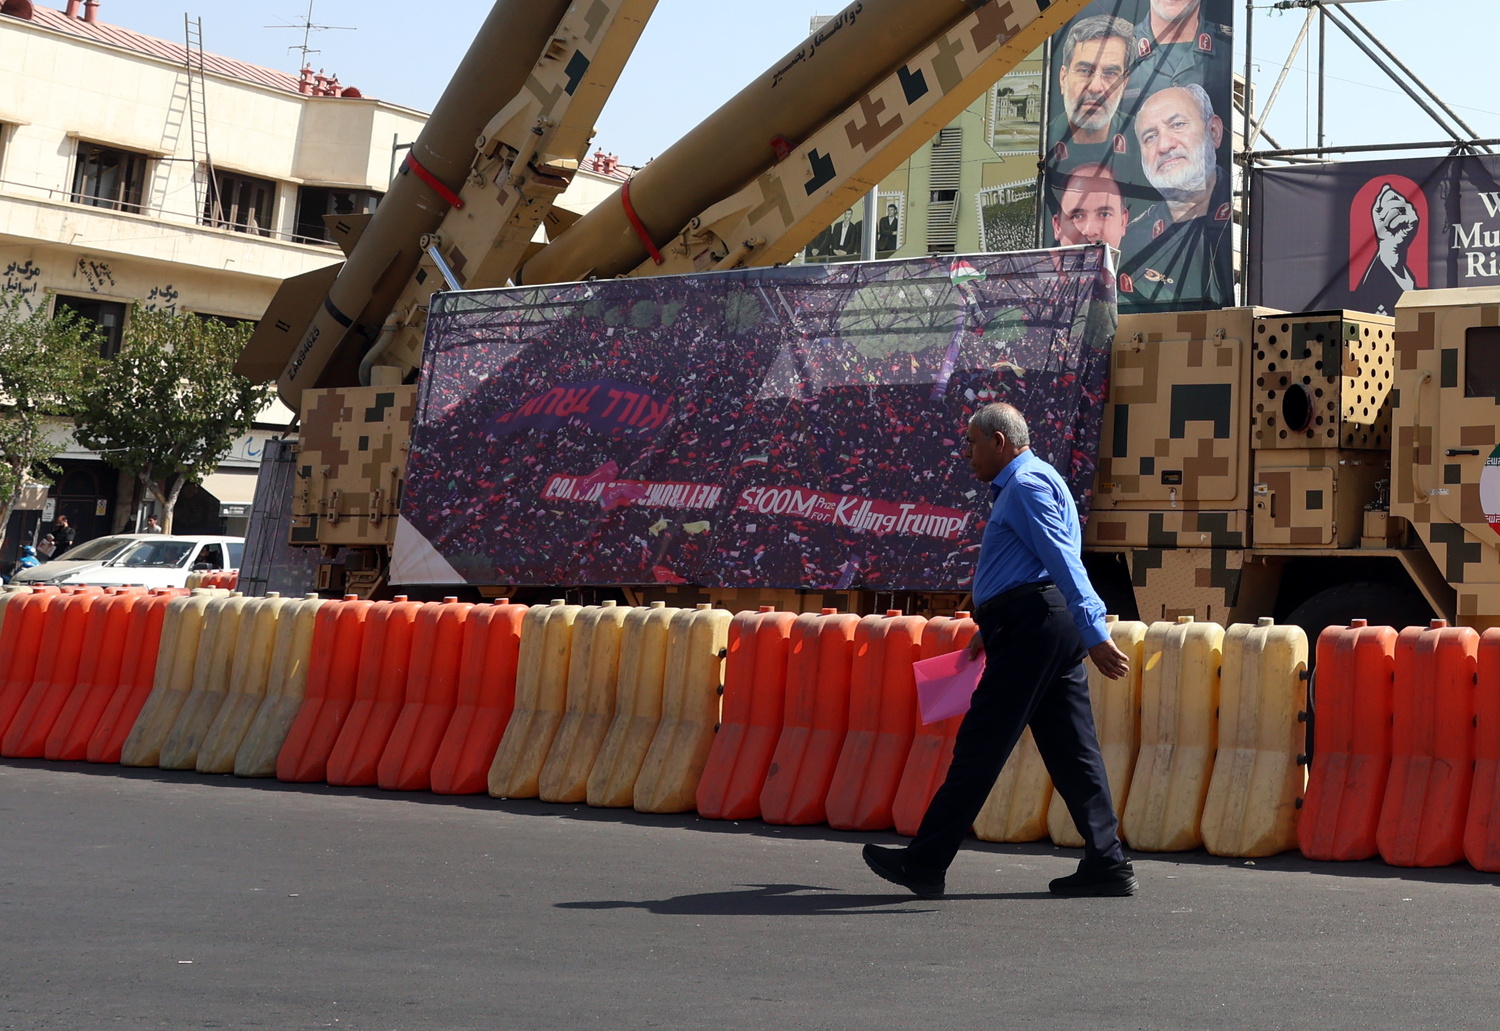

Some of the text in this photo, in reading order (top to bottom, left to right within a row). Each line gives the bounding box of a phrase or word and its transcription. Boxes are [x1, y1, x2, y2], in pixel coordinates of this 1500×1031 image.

[3, 260, 40, 280] مرگ بر
[147, 284, 178, 303] مرگ بر
[601, 389, 676, 429] KILL
[833, 496, 897, 532] Killing
